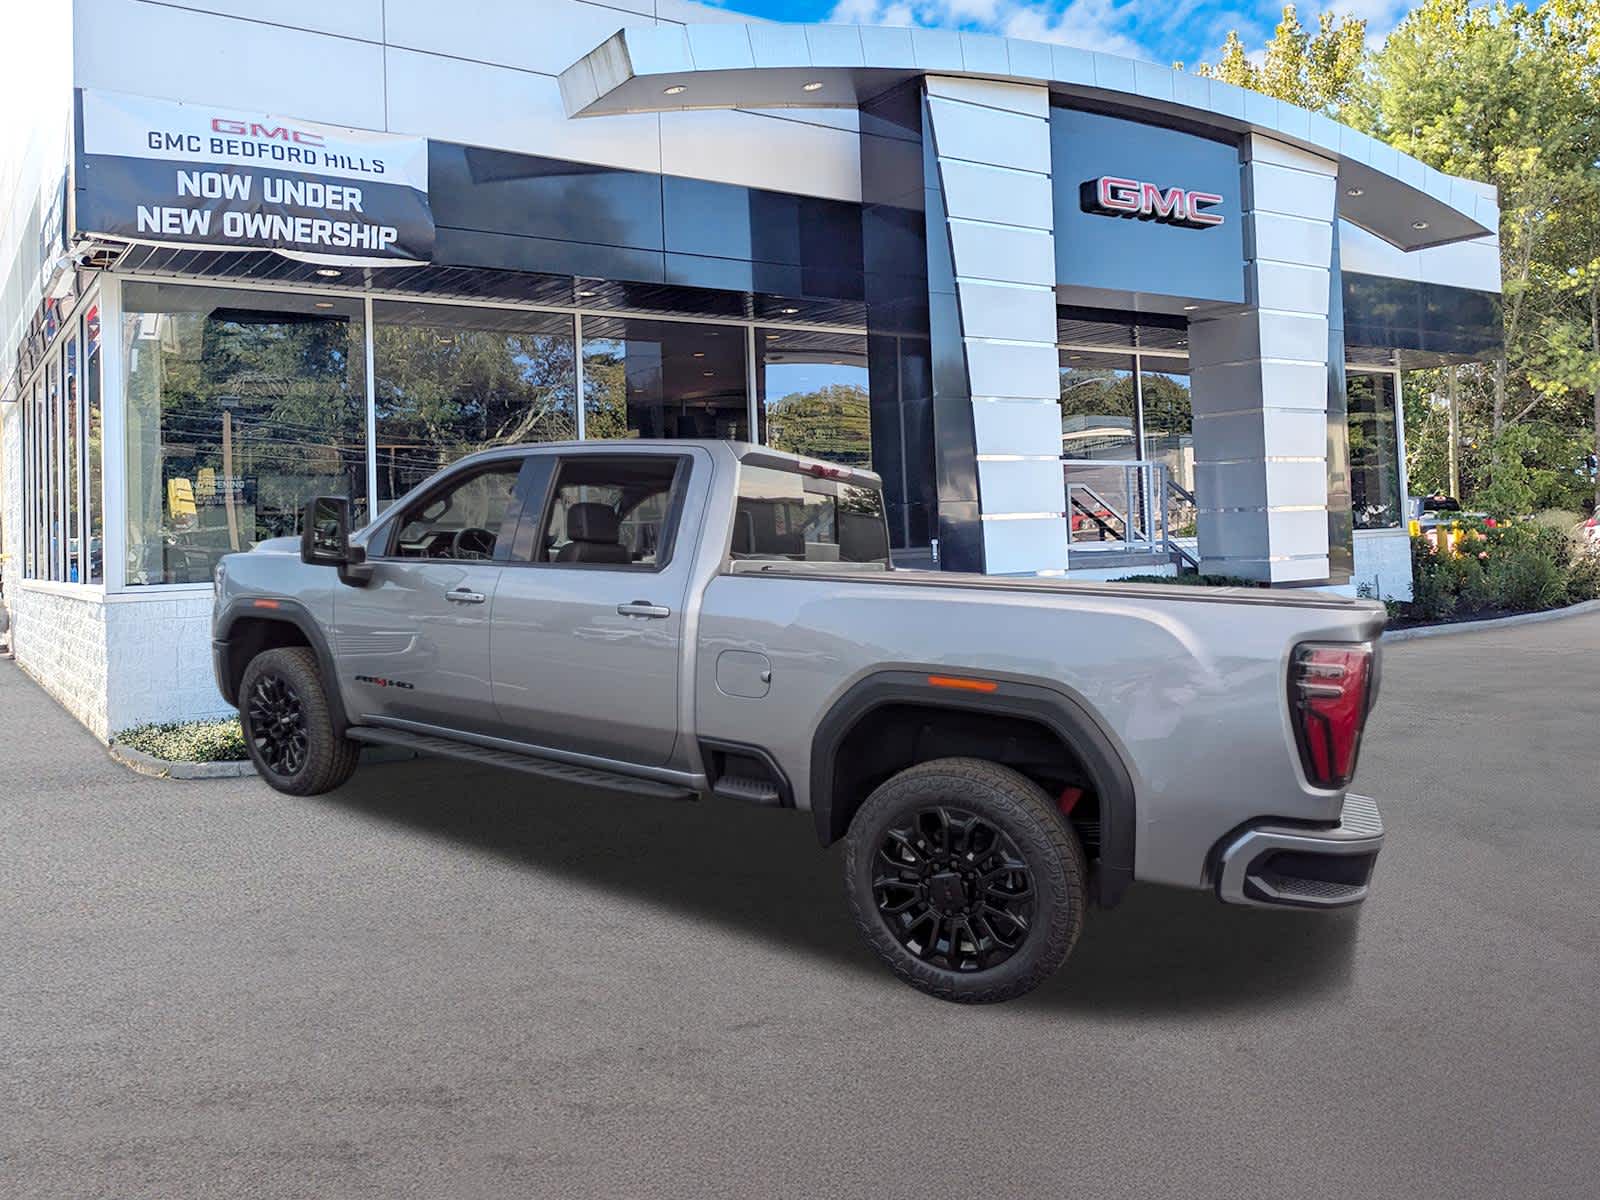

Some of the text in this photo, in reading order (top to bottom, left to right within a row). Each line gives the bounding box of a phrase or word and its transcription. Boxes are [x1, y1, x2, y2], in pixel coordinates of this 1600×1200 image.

[148, 131, 385, 174] GMC BEDFORD HILLS
[211, 118, 326, 148] GMC
[177, 170, 363, 213] NOW UNDER
[1098, 176, 1225, 225] GMC
[137, 205, 398, 250] NEW OWNERSHIP
